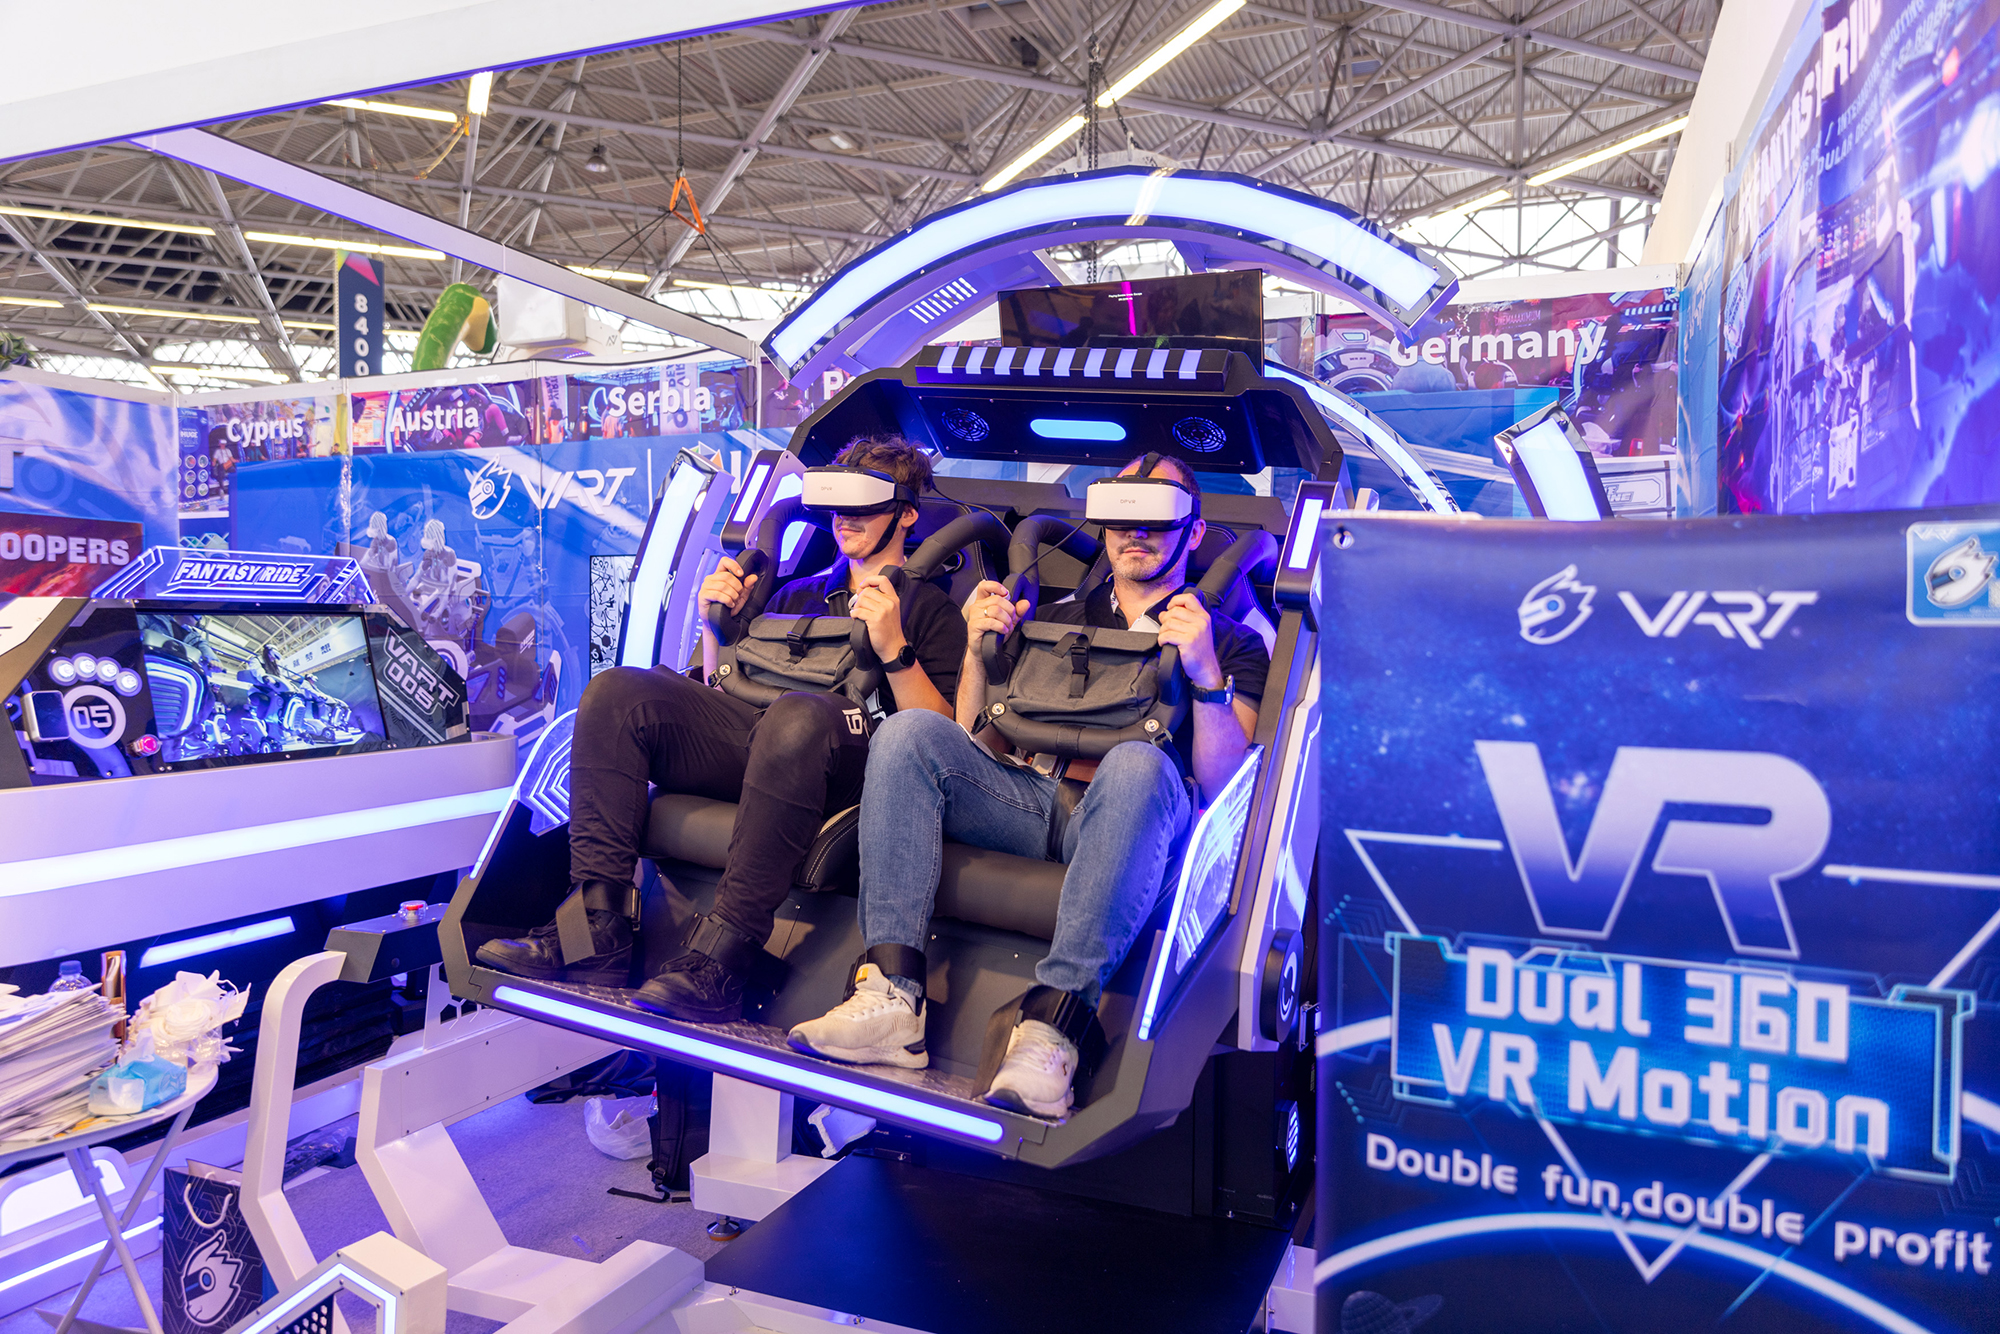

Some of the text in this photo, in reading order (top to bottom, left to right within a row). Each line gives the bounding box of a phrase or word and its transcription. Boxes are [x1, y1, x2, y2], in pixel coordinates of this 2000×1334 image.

[353, 293, 370, 377] 8400
[1389, 325, 1607, 367] Germany
[392, 401, 479, 435] Austria
[609, 378, 711, 417] Serbia
[226, 417, 304, 448] Cyprus
[0, 532, 130, 566] OOPERS
[178, 562, 305, 583] FANTASY RIDE
[388, 635, 454, 702] VART
[388, 661, 435, 710] 005
[71, 704, 110, 729] 05
[1474, 739, 1831, 957] VR
[1465, 946, 1849, 1062] Dual 360
[1432, 1023, 1889, 1159] VR Motion
[1366, 1132, 1993, 1275] Double fun,double profit
